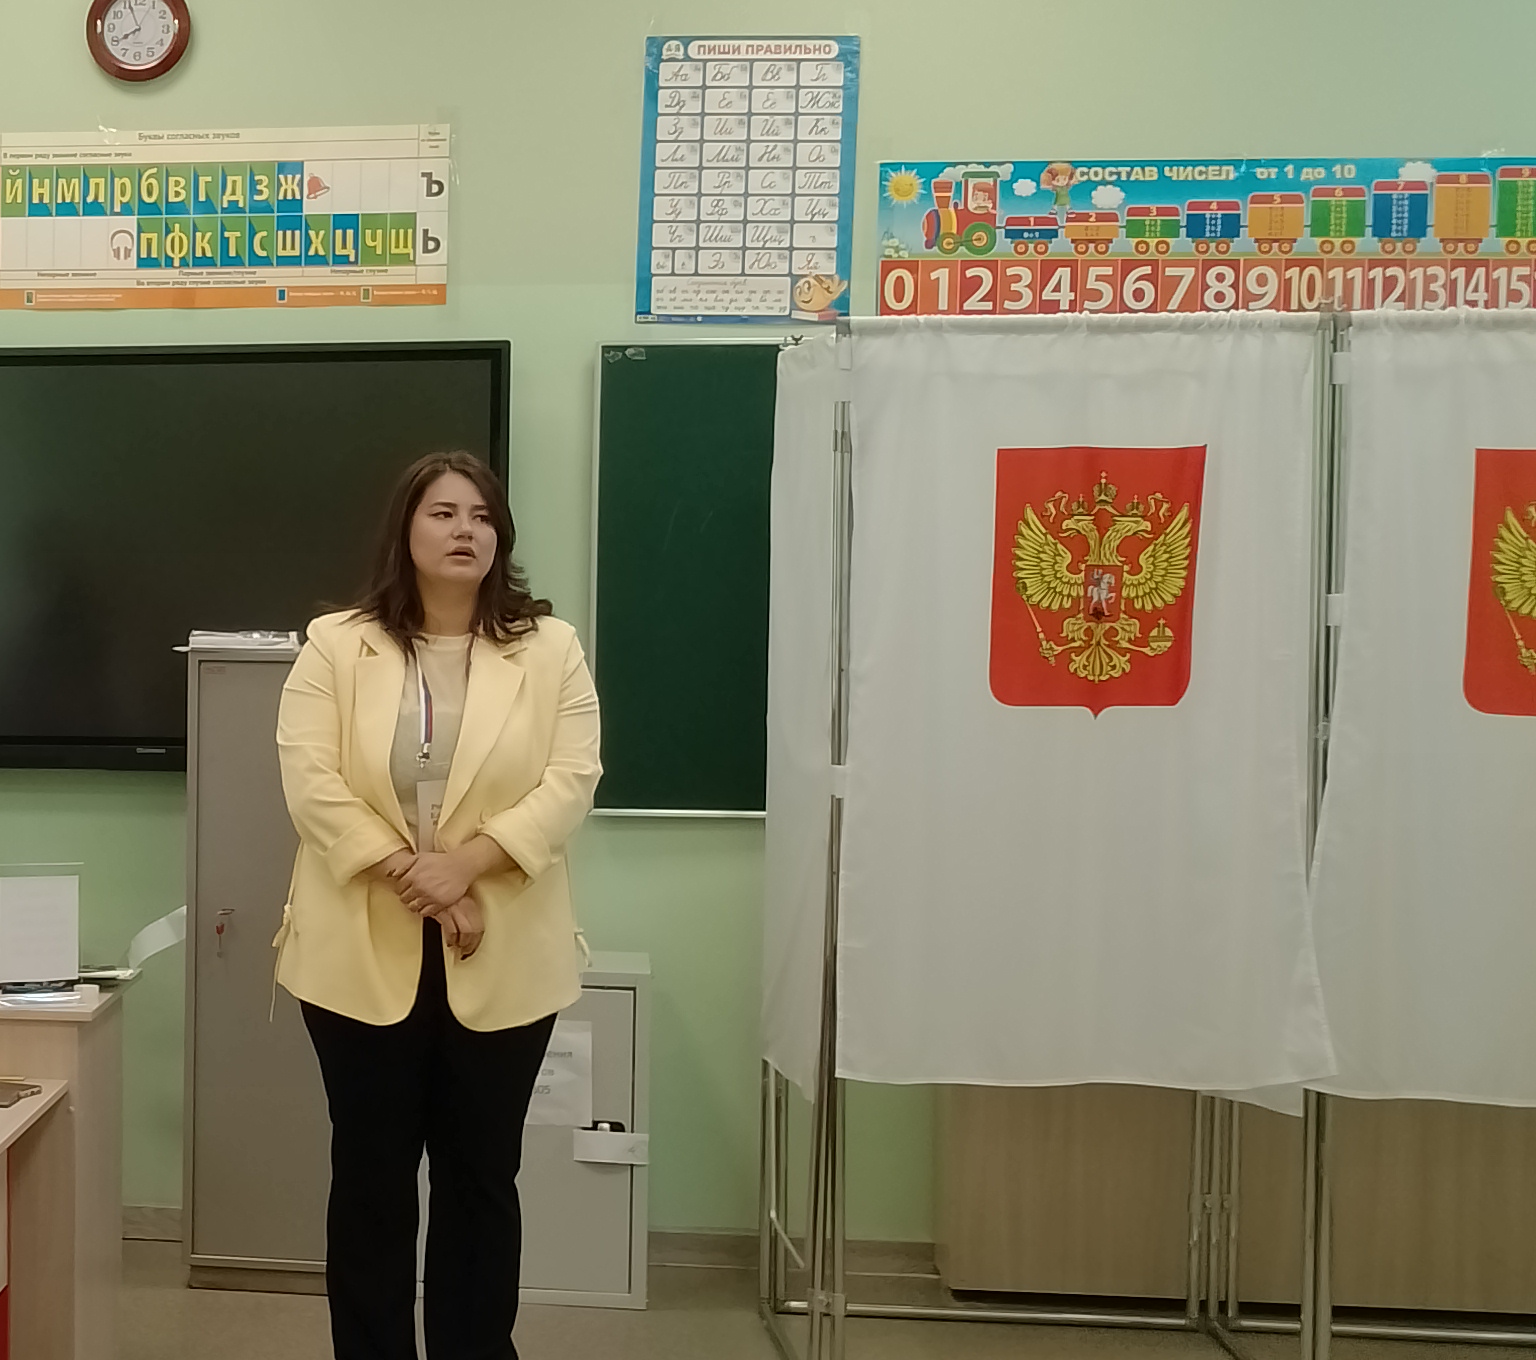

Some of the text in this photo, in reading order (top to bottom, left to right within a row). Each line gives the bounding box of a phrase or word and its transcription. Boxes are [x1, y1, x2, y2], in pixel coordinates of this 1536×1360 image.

[151, 0, 156, 9] 1
[112, 10, 123, 20] 10
[158, 10, 167, 20] 2
[107, 23, 116, 33] 9
[161, 24, 170, 34] 3
[110, 36, 120, 47] 8
[156, 38, 164, 47] 4
[120, 47, 129, 57] 7
[146, 47, 155, 57] 5
[697, 43, 832, 55] ПИШИ ПРАВИЛЬНО
[133, 51, 142, 61] 6
[664, 64, 691, 82] Аа
[710, 63, 739, 82] Бб
[760, 63, 782, 82] Вв
[138, 132, 165, 142] Буквы
[757, 144, 782, 163] Нн
[807, 144, 826, 164] Оо
[1075, 164, 1356, 181] СОСТАВ ЧИСЕЛ от 1 до 10
[420, 172, 445, 198] ъ
[760, 171, 777, 190] Сс
[5, 167, 302, 213] й н м л р б в г д з ж
[1396, 181, 1406, 192] 7
[1272, 193, 1281, 204] 5
[1149, 205, 1157, 217] 3
[1209, 201, 1218, 211] 4
[1028, 216, 1035, 227] 1
[1088, 212, 1097, 222] 2
[139, 222, 414, 267] п ф к т с ш х ц ч щ
[421, 228, 442, 255] ь
[883, 265, 1531, 311] 0 1 2 3 4 5 6 7 8 9 10 11 12 13 14 15
